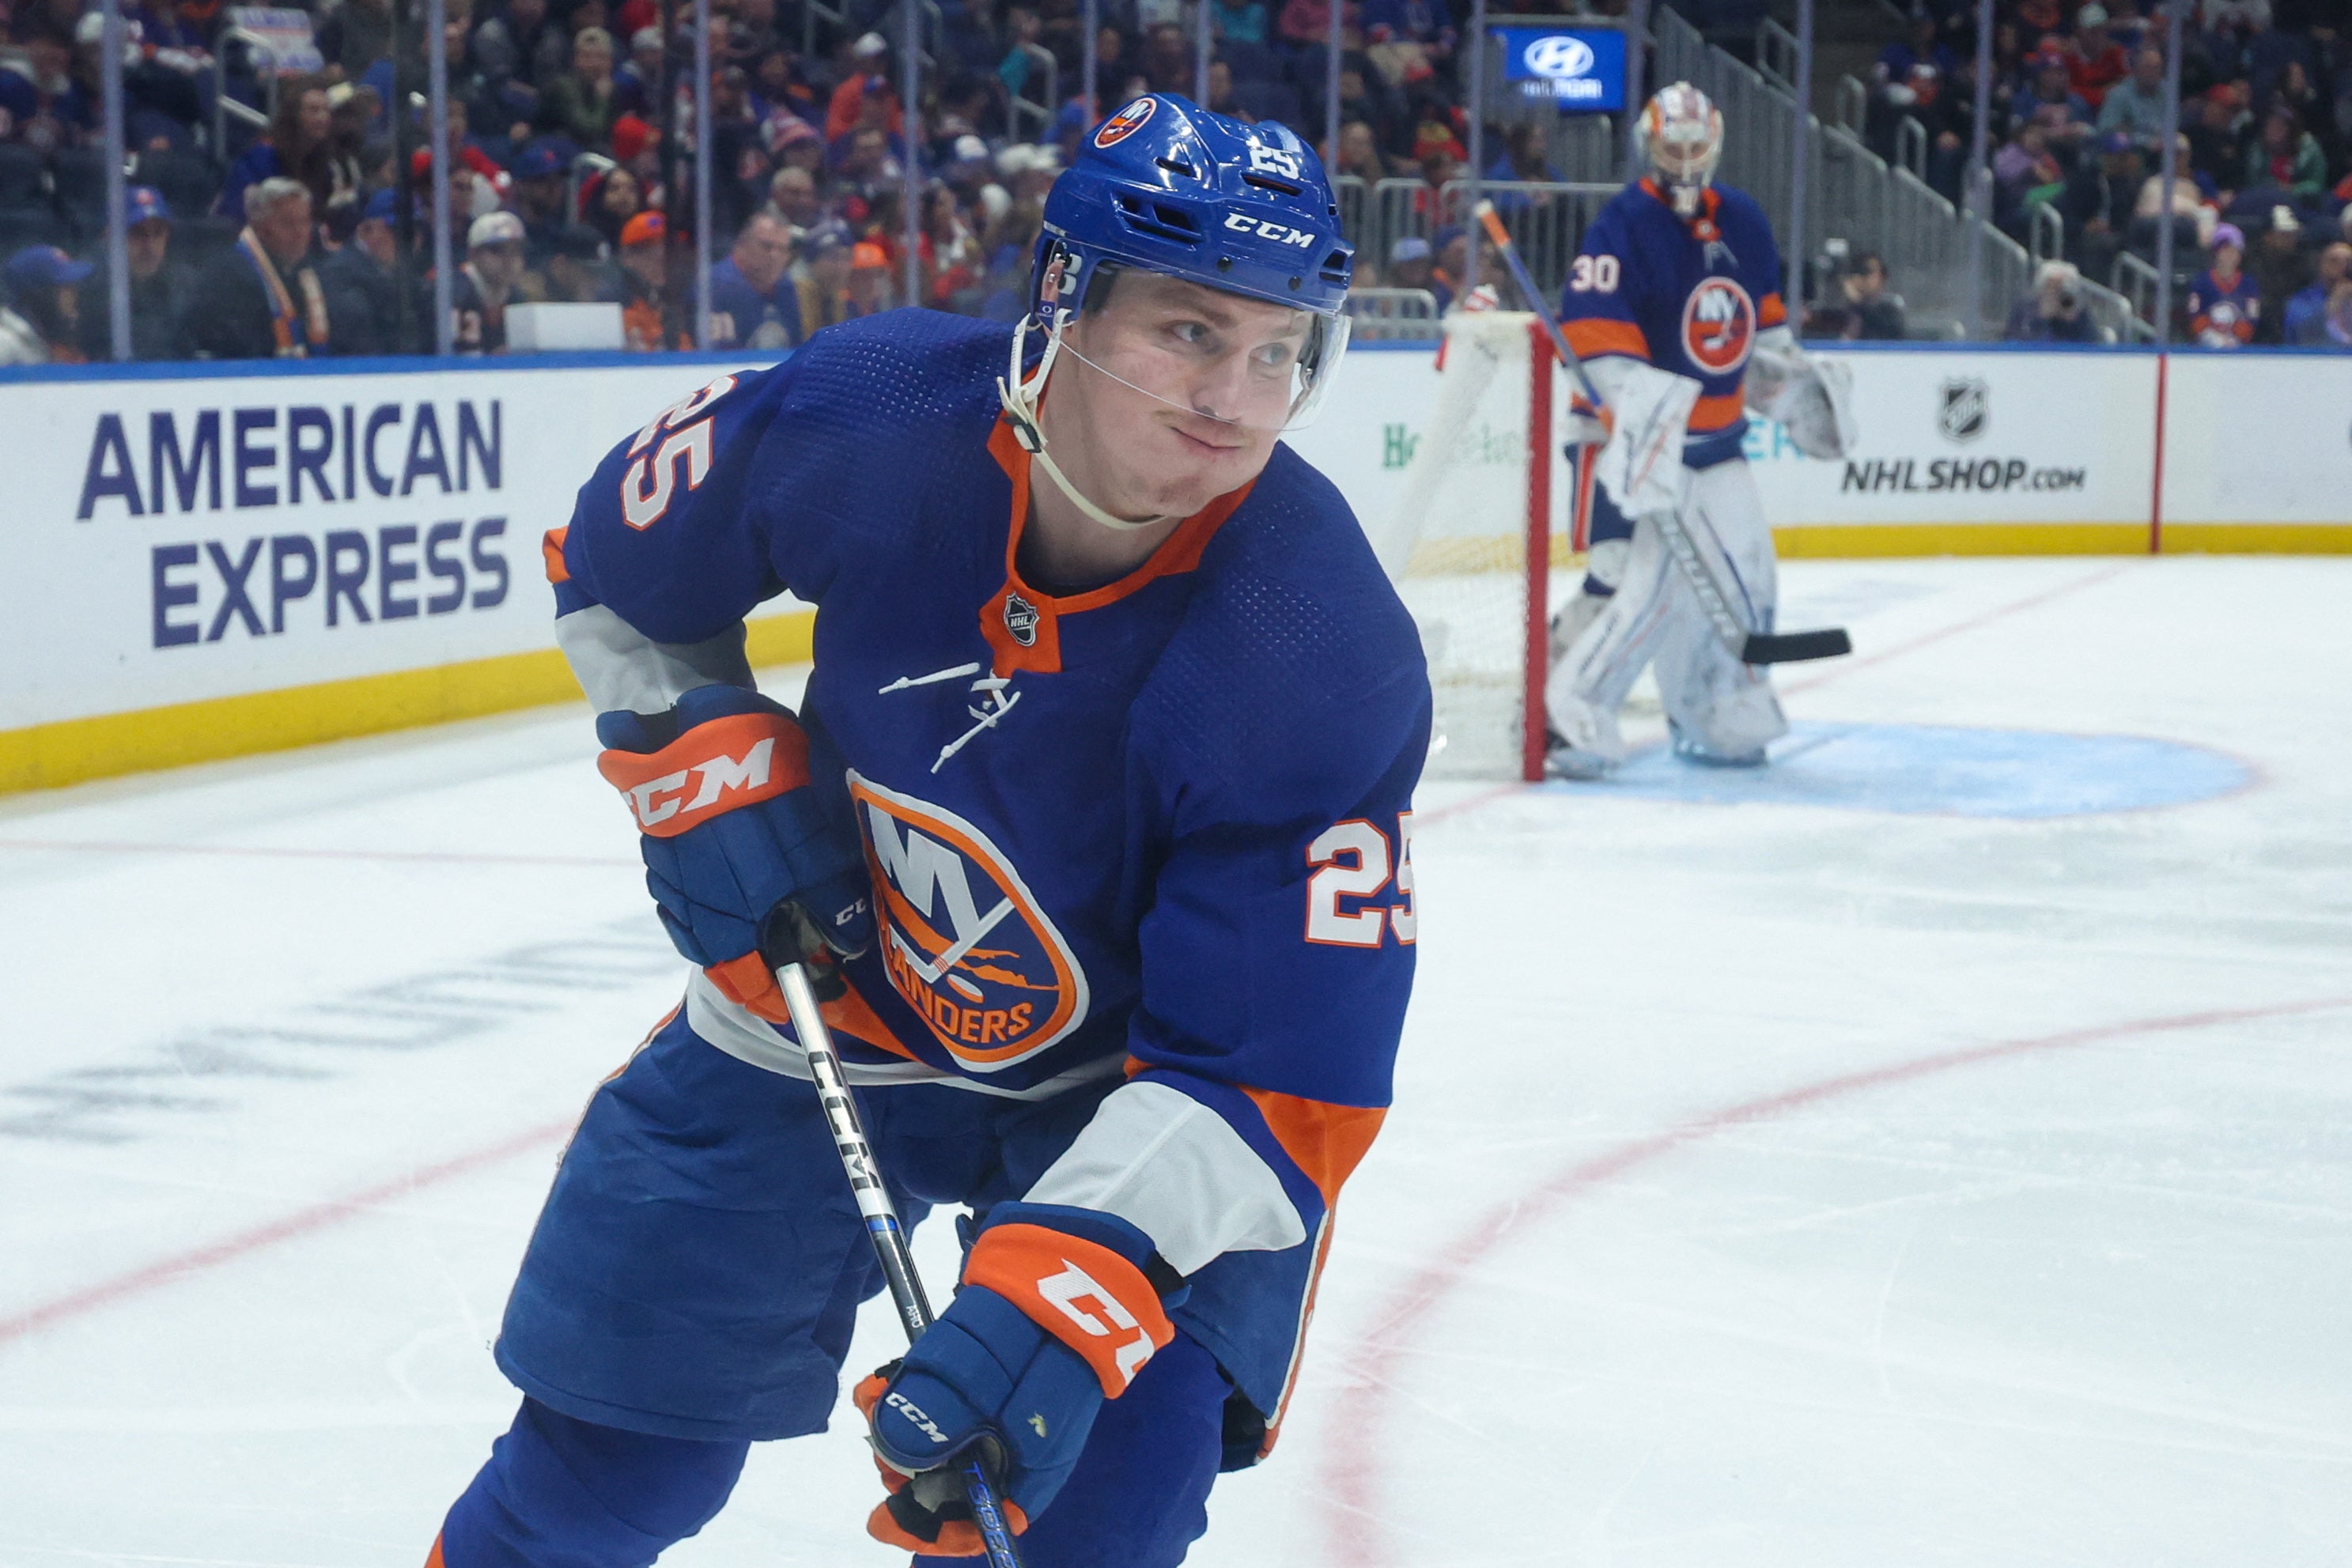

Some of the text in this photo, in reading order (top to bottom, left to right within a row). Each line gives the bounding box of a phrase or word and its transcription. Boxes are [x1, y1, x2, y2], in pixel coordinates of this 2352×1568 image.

[1250, 147, 1300, 180] 25
[1223, 213, 1315, 249] CCM
[1569, 254, 1620, 293] 30
[76, 399, 501, 522] AMERICAN
[151, 516, 509, 649] EXPRESS
[1010, 615, 1030, 628] NHL
[622, 737, 774, 827] CM
[885, 921, 1034, 1044] ANDERS
[807, 1050, 882, 1192] CCM
[885, 1392, 949, 1444] CCM
